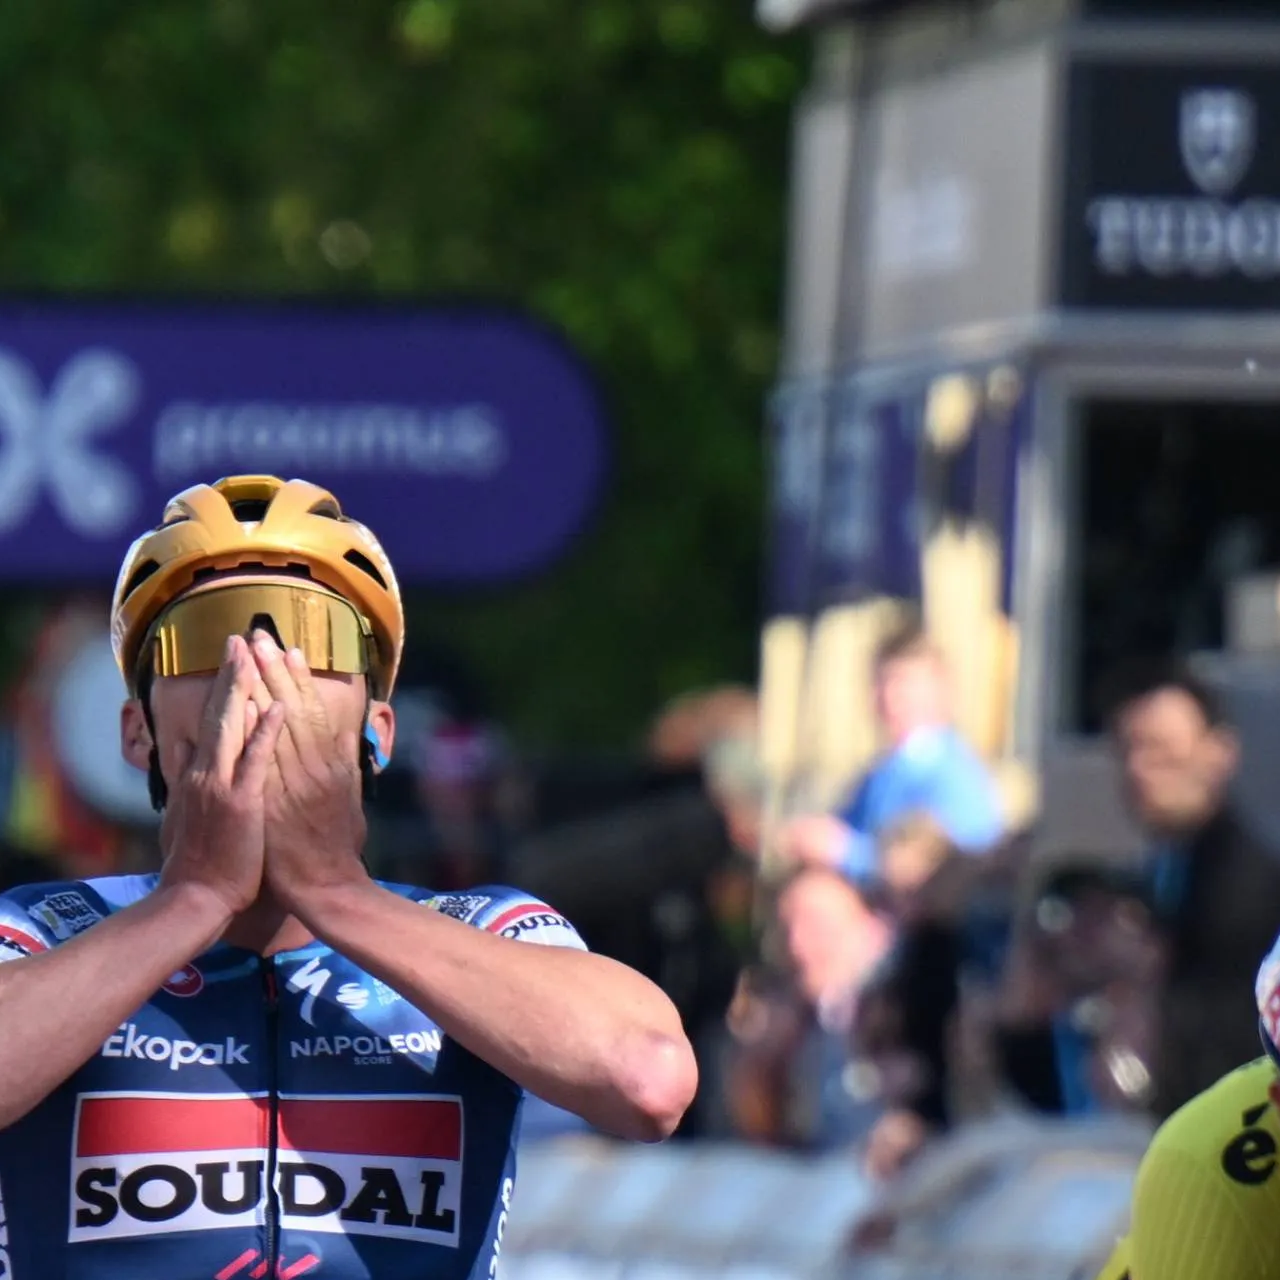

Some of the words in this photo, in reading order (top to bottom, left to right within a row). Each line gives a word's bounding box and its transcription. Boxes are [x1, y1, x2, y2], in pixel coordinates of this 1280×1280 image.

[102, 1022, 251, 1071] Ekopak
[290, 1029, 442, 1059] NAPOLEON
[75, 1159, 456, 1234] SOUDAL
